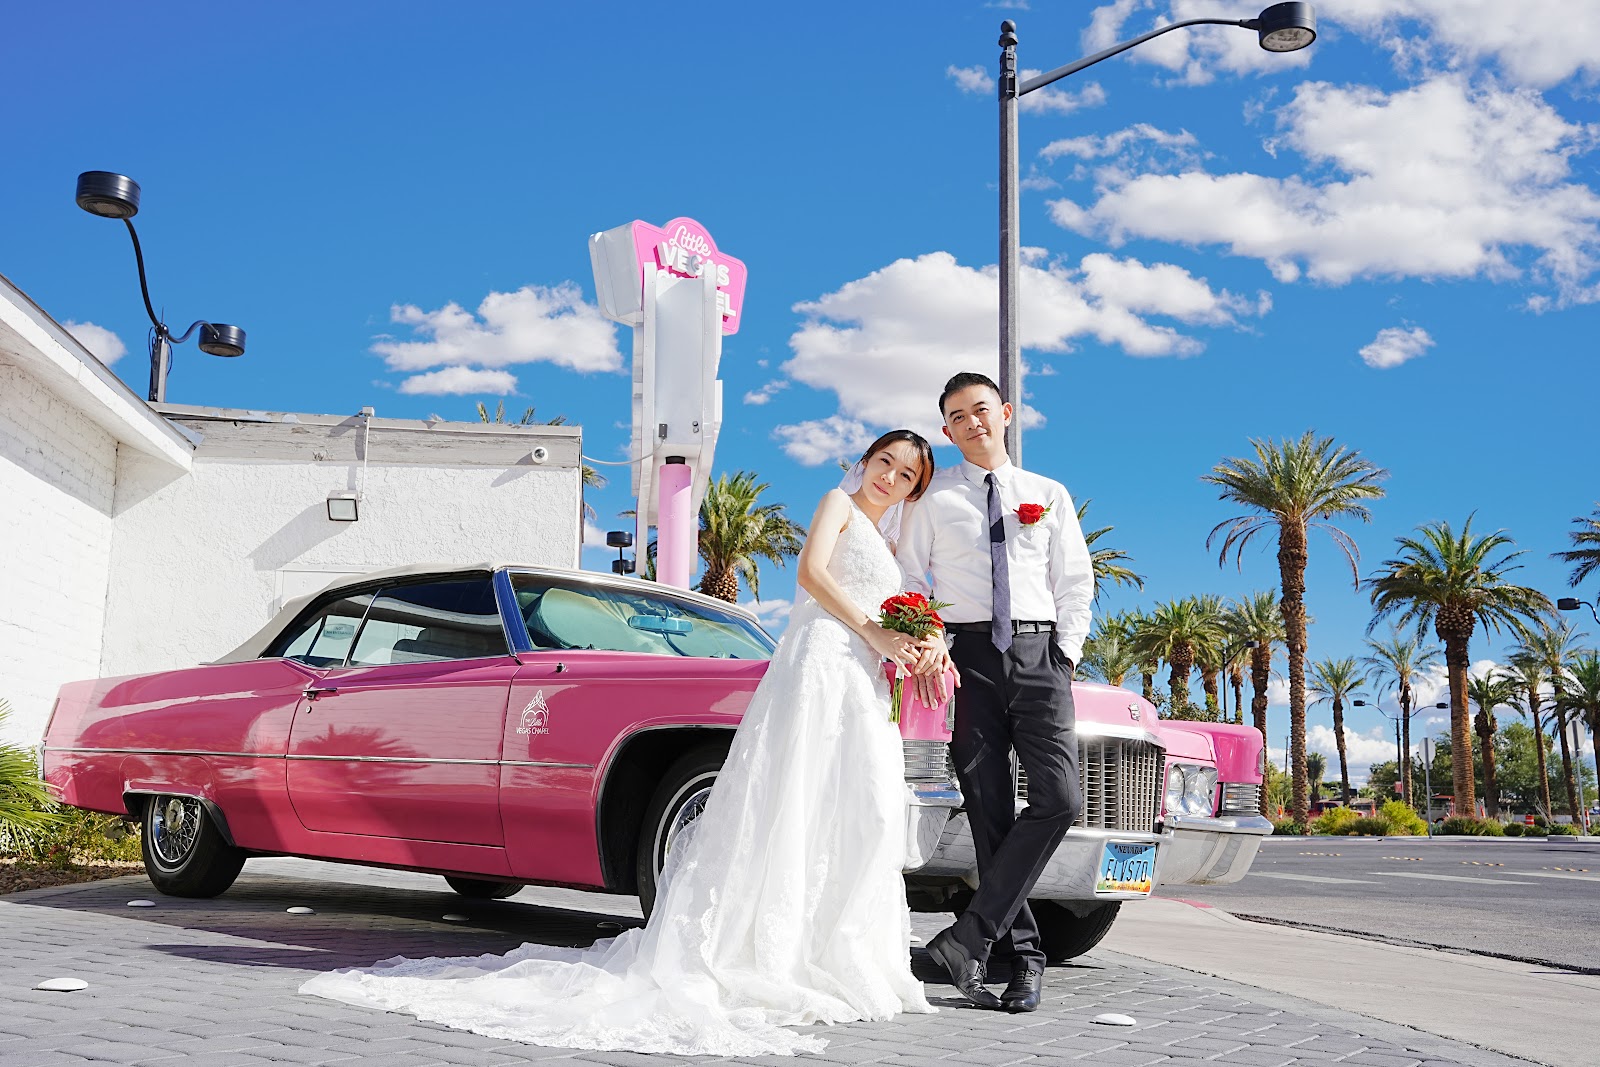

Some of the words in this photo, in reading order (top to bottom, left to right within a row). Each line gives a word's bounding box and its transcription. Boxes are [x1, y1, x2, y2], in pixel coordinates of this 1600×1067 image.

[669, 225, 711, 256] Little
[660, 242, 730, 286] VEGS
[1118, 846, 1142, 854] NEVADA
